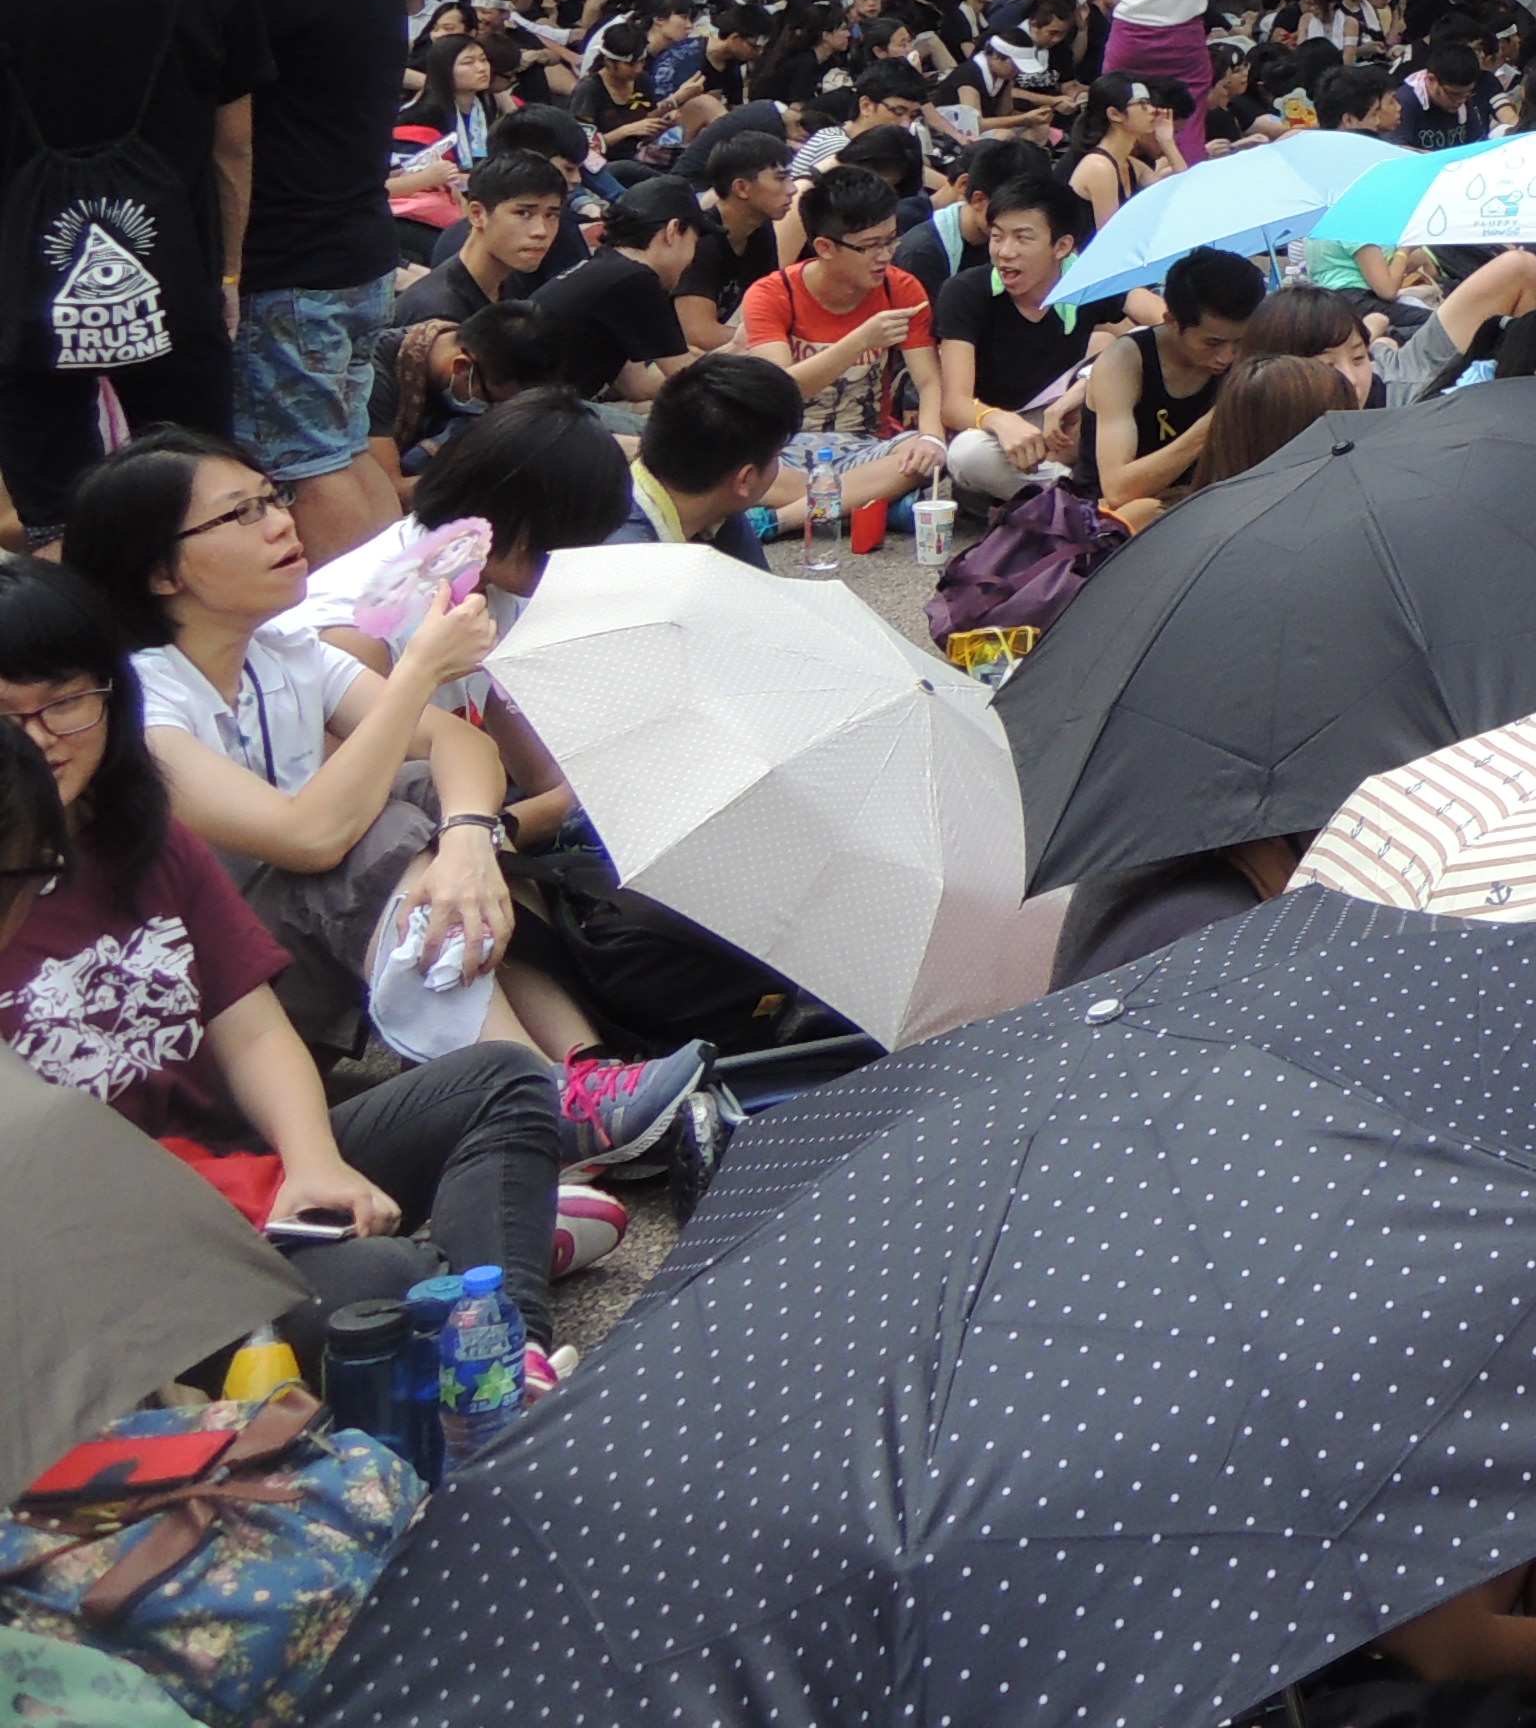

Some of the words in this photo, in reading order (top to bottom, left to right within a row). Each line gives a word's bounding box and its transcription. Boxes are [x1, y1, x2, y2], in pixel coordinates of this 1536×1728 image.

[1472, 219, 1519, 227] FLUFFY
[53, 286, 162, 328] DON'T
[55, 309, 167, 349] TRUST
[57, 330, 173, 363] ANYONE
